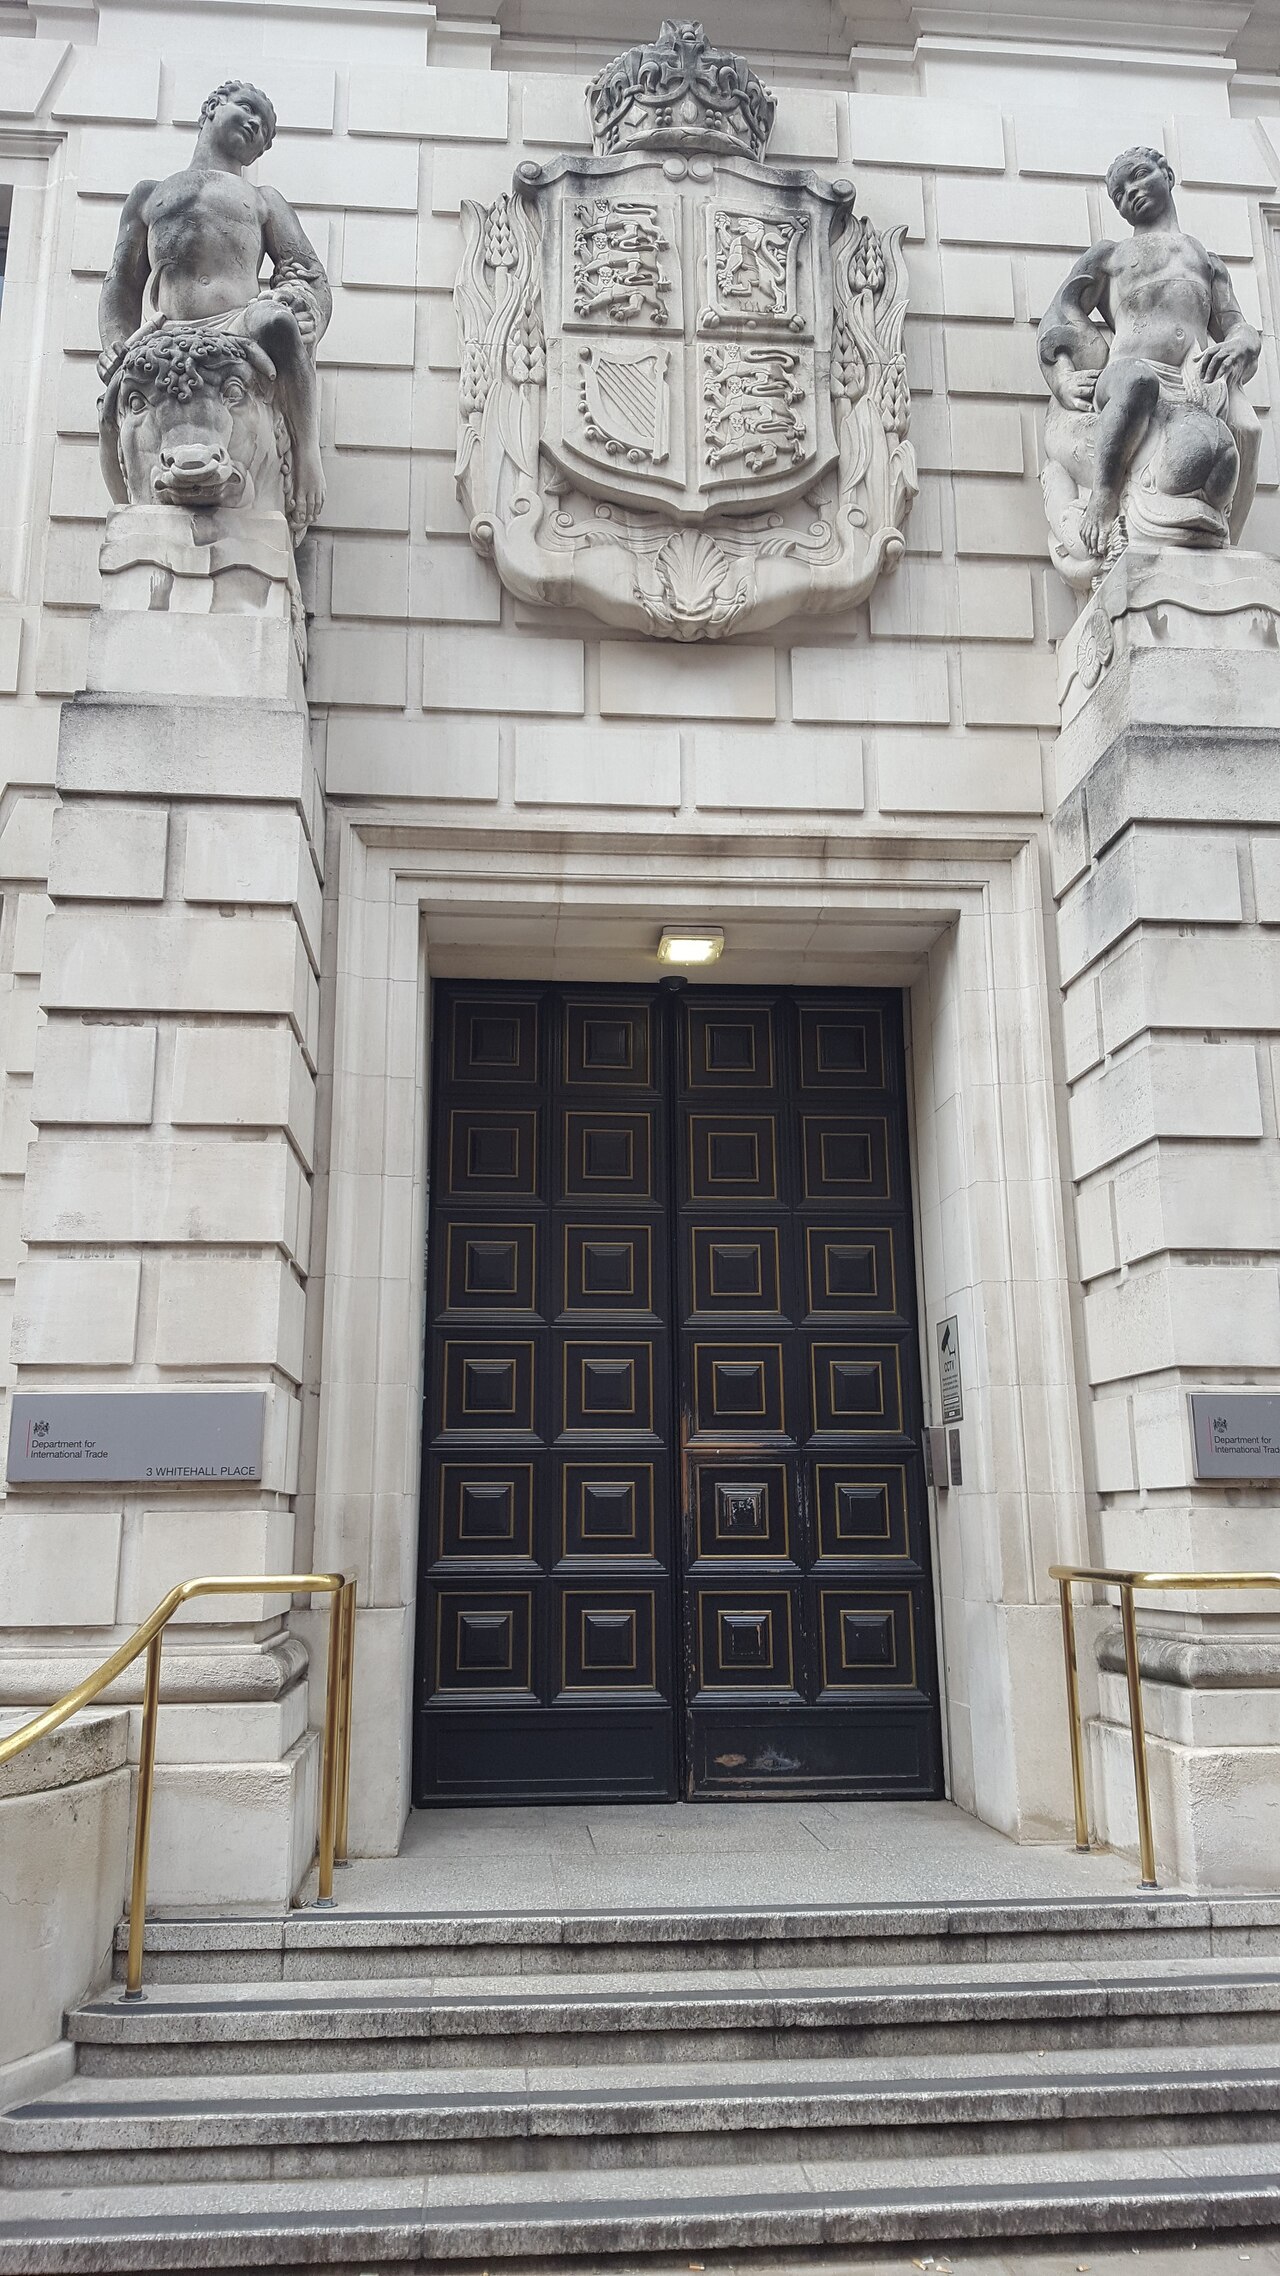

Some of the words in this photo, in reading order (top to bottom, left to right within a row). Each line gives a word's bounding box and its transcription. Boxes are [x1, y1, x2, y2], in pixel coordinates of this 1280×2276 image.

[944, 1360, 955, 1373] CCTV
[31, 1440, 82, 1449] Department
[84, 1440, 96, 1448] for
[1214, 1435, 1260, 1445] Department
[1261, 1435, 1271, 1444] for
[1215, 1445, 1261, 1453] International
[1263, 1445, 1280, 1453] Trad
[30, 1450, 82, 1458] International
[85, 1450, 108, 1458] Trade
[146, 1467, 153, 1477] 3
[156, 1466, 217, 1476] WHITEHALL
[220, 1466, 256, 1476] PLACE
